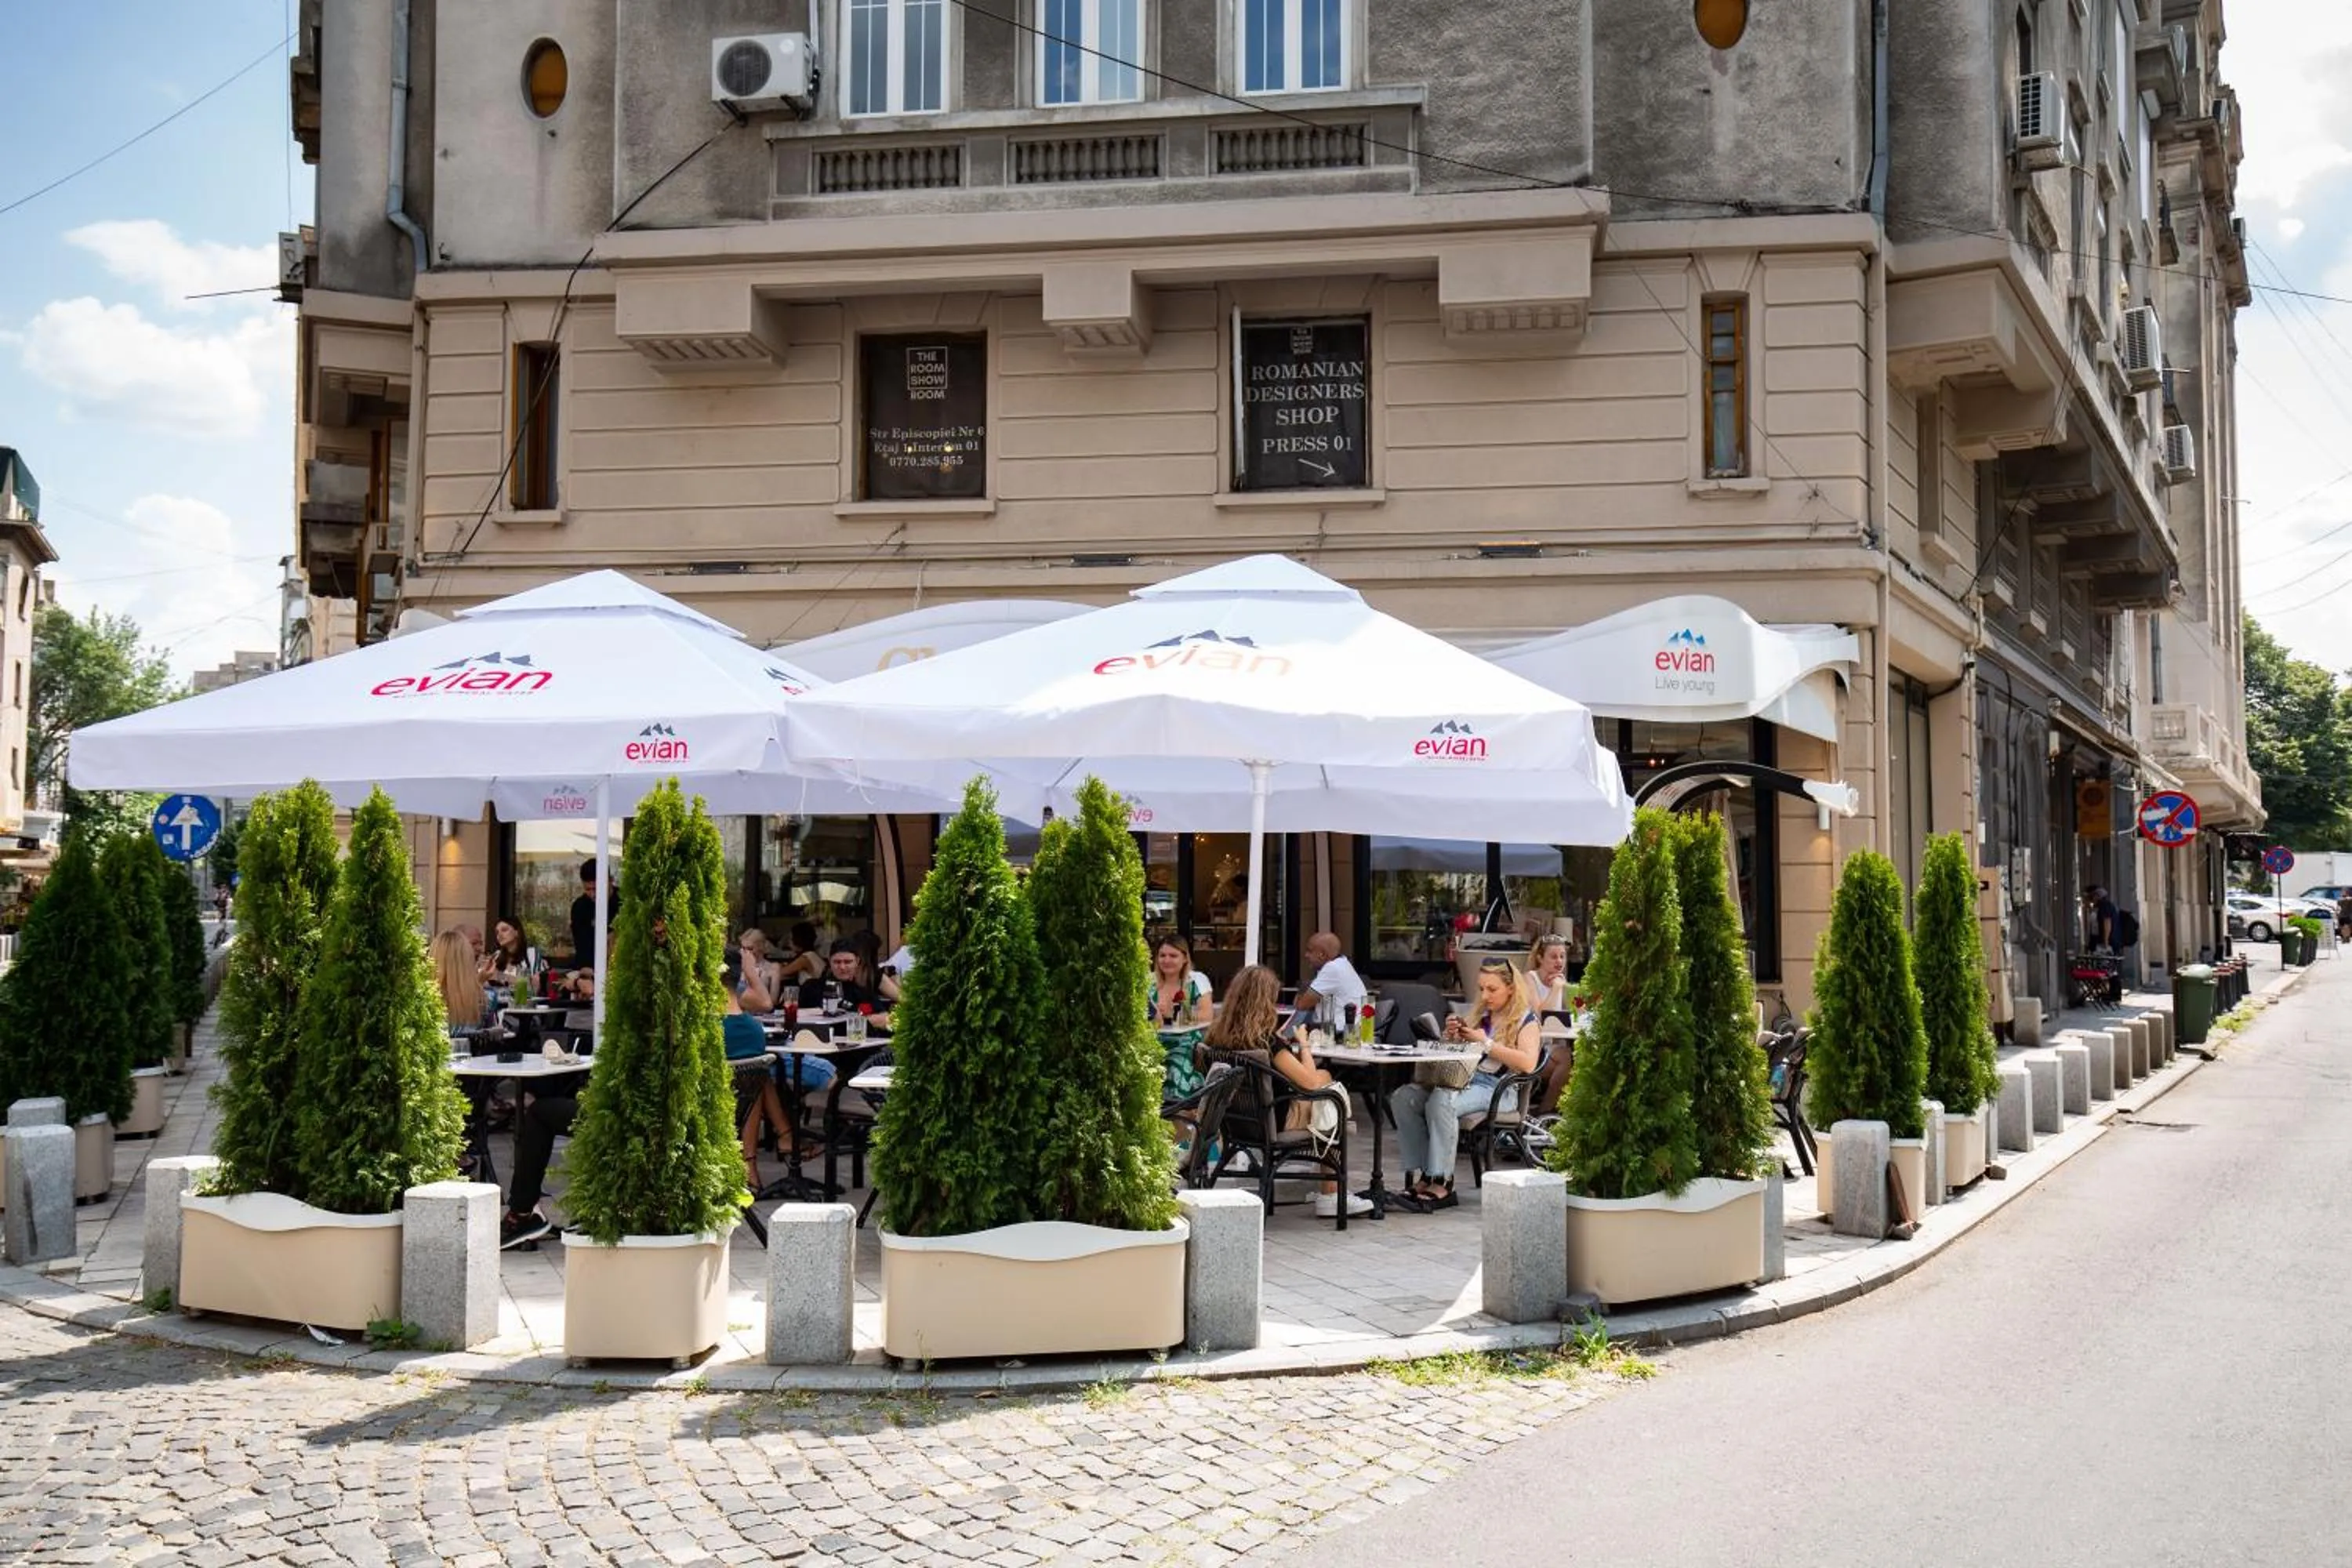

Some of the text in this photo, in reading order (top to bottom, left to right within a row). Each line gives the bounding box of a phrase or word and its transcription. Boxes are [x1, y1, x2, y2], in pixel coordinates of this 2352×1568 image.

[916, 351, 938, 361] THE
[910, 363, 945, 373] ROOM
[1251, 361, 1365, 380] ROMANIAN
[910, 376, 945, 385] SHOW
[910, 389, 945, 399] ROOM
[1243, 383, 1365, 402] DESIGNERS
[1275, 406, 1340, 426] SHOP
[891, 426, 955, 440] Episcopiei
[957, 426, 975, 437] Nr
[874, 442, 900, 454] Etaj
[913, 441, 963, 452] Interfn
[966, 440, 979, 451] 01
[1261, 435, 1353, 454] PRESS 01
[1093, 644, 1293, 675] evian
[1655, 647, 1715, 674] evian
[371, 667, 553, 695] evian
[1655, 676, 1715, 696] Live young
[626, 738, 688, 760] evian
[1415, 736, 1486, 756] evian
